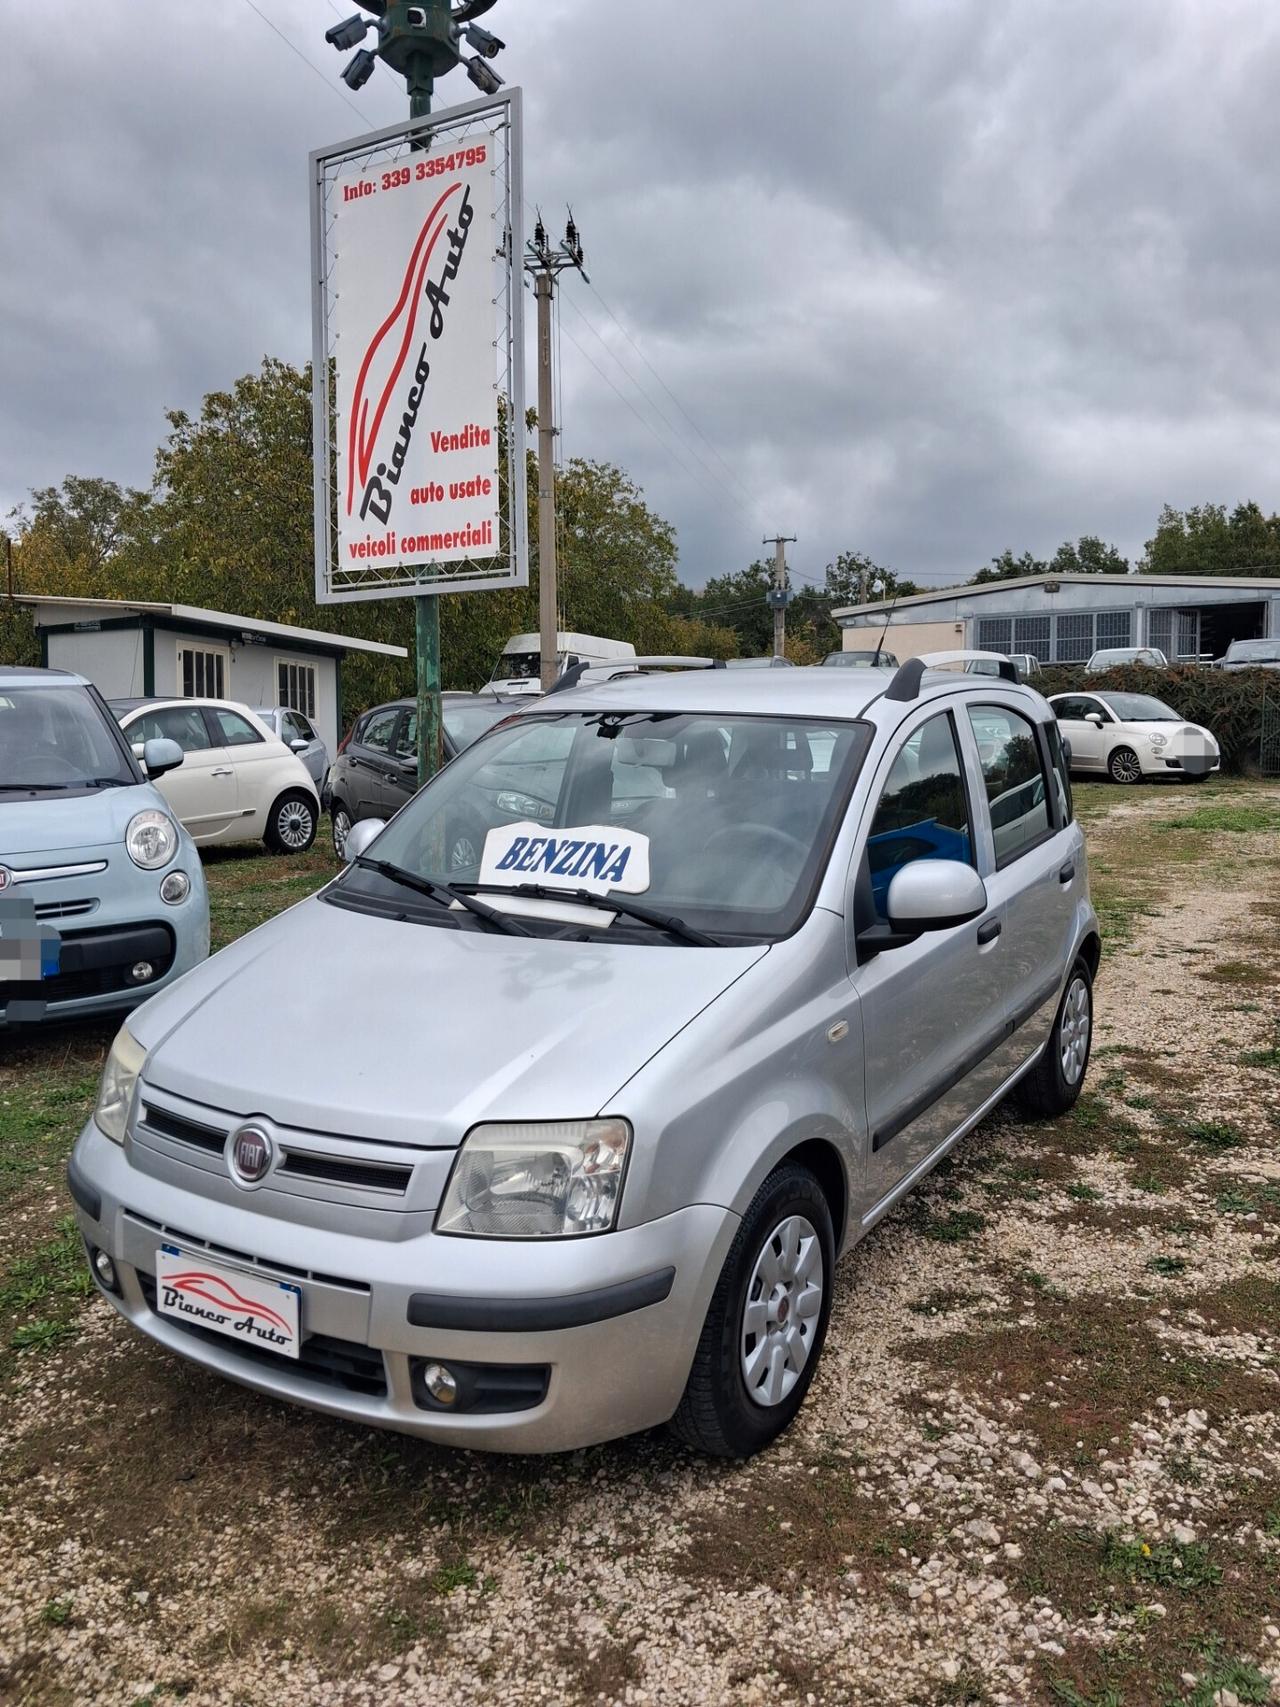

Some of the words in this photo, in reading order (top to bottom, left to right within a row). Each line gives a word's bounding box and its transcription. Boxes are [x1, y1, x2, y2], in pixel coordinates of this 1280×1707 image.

[343, 181, 377, 202] Info:
[381, 167, 411, 191] 339
[415, 145, 487, 181] 3354795
[359, 342, 430, 525] Bianco
[425, 184, 474, 339] Auto
[430, 424, 491, 453] Vendita
[410, 481, 444, 505] auto
[449, 474, 492, 500] usate
[349, 532, 396, 559] veicoli
[400, 519, 492, 554] commerciali
[495, 837, 632, 883] BENZINA
[240, 1142, 263, 1169] FIAT
[161, 1285, 232, 1325] Bianco
[234, 1316, 292, 1346] Auto
